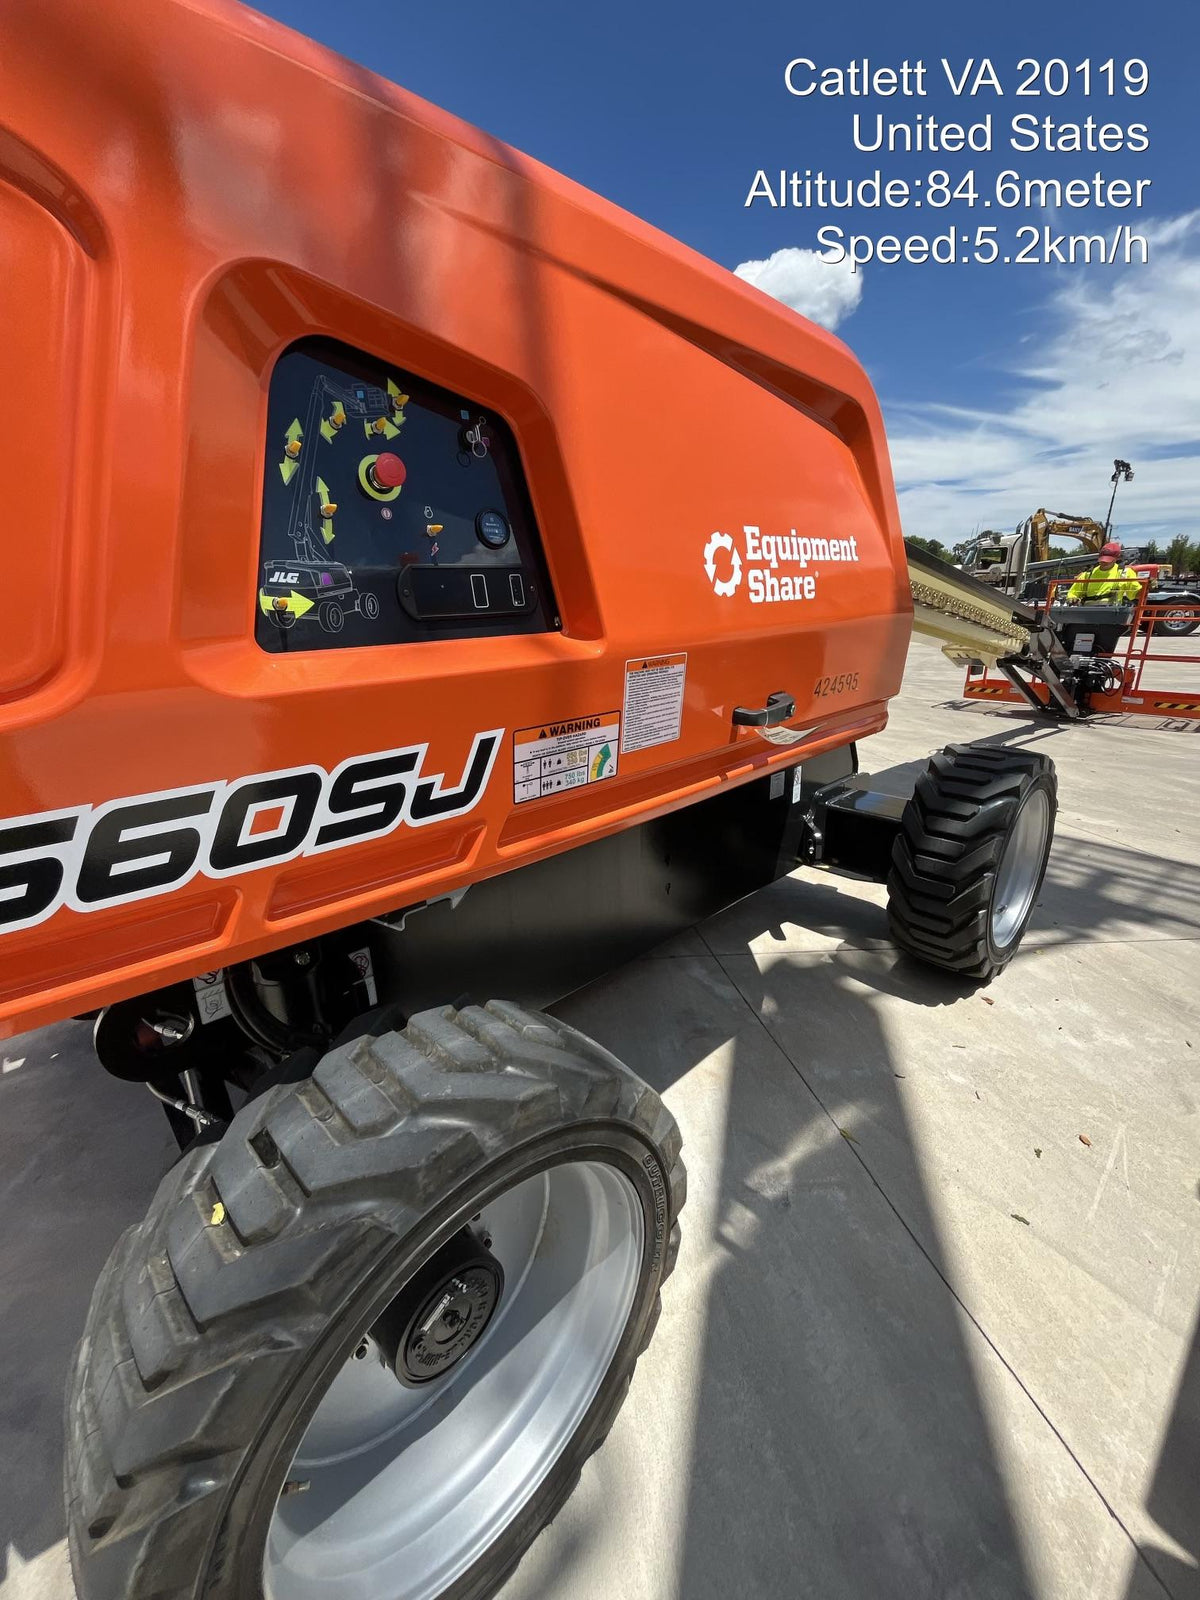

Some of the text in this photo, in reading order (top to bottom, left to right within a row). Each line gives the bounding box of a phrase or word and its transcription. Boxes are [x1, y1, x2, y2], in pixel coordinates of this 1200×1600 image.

[743, 525, 859, 569] Equipment
[269, 571, 299, 584] JLG
[748, 569, 816, 603] Share
[814, 672, 860, 698] 424595
[549, 717, 601, 737] WARNING
